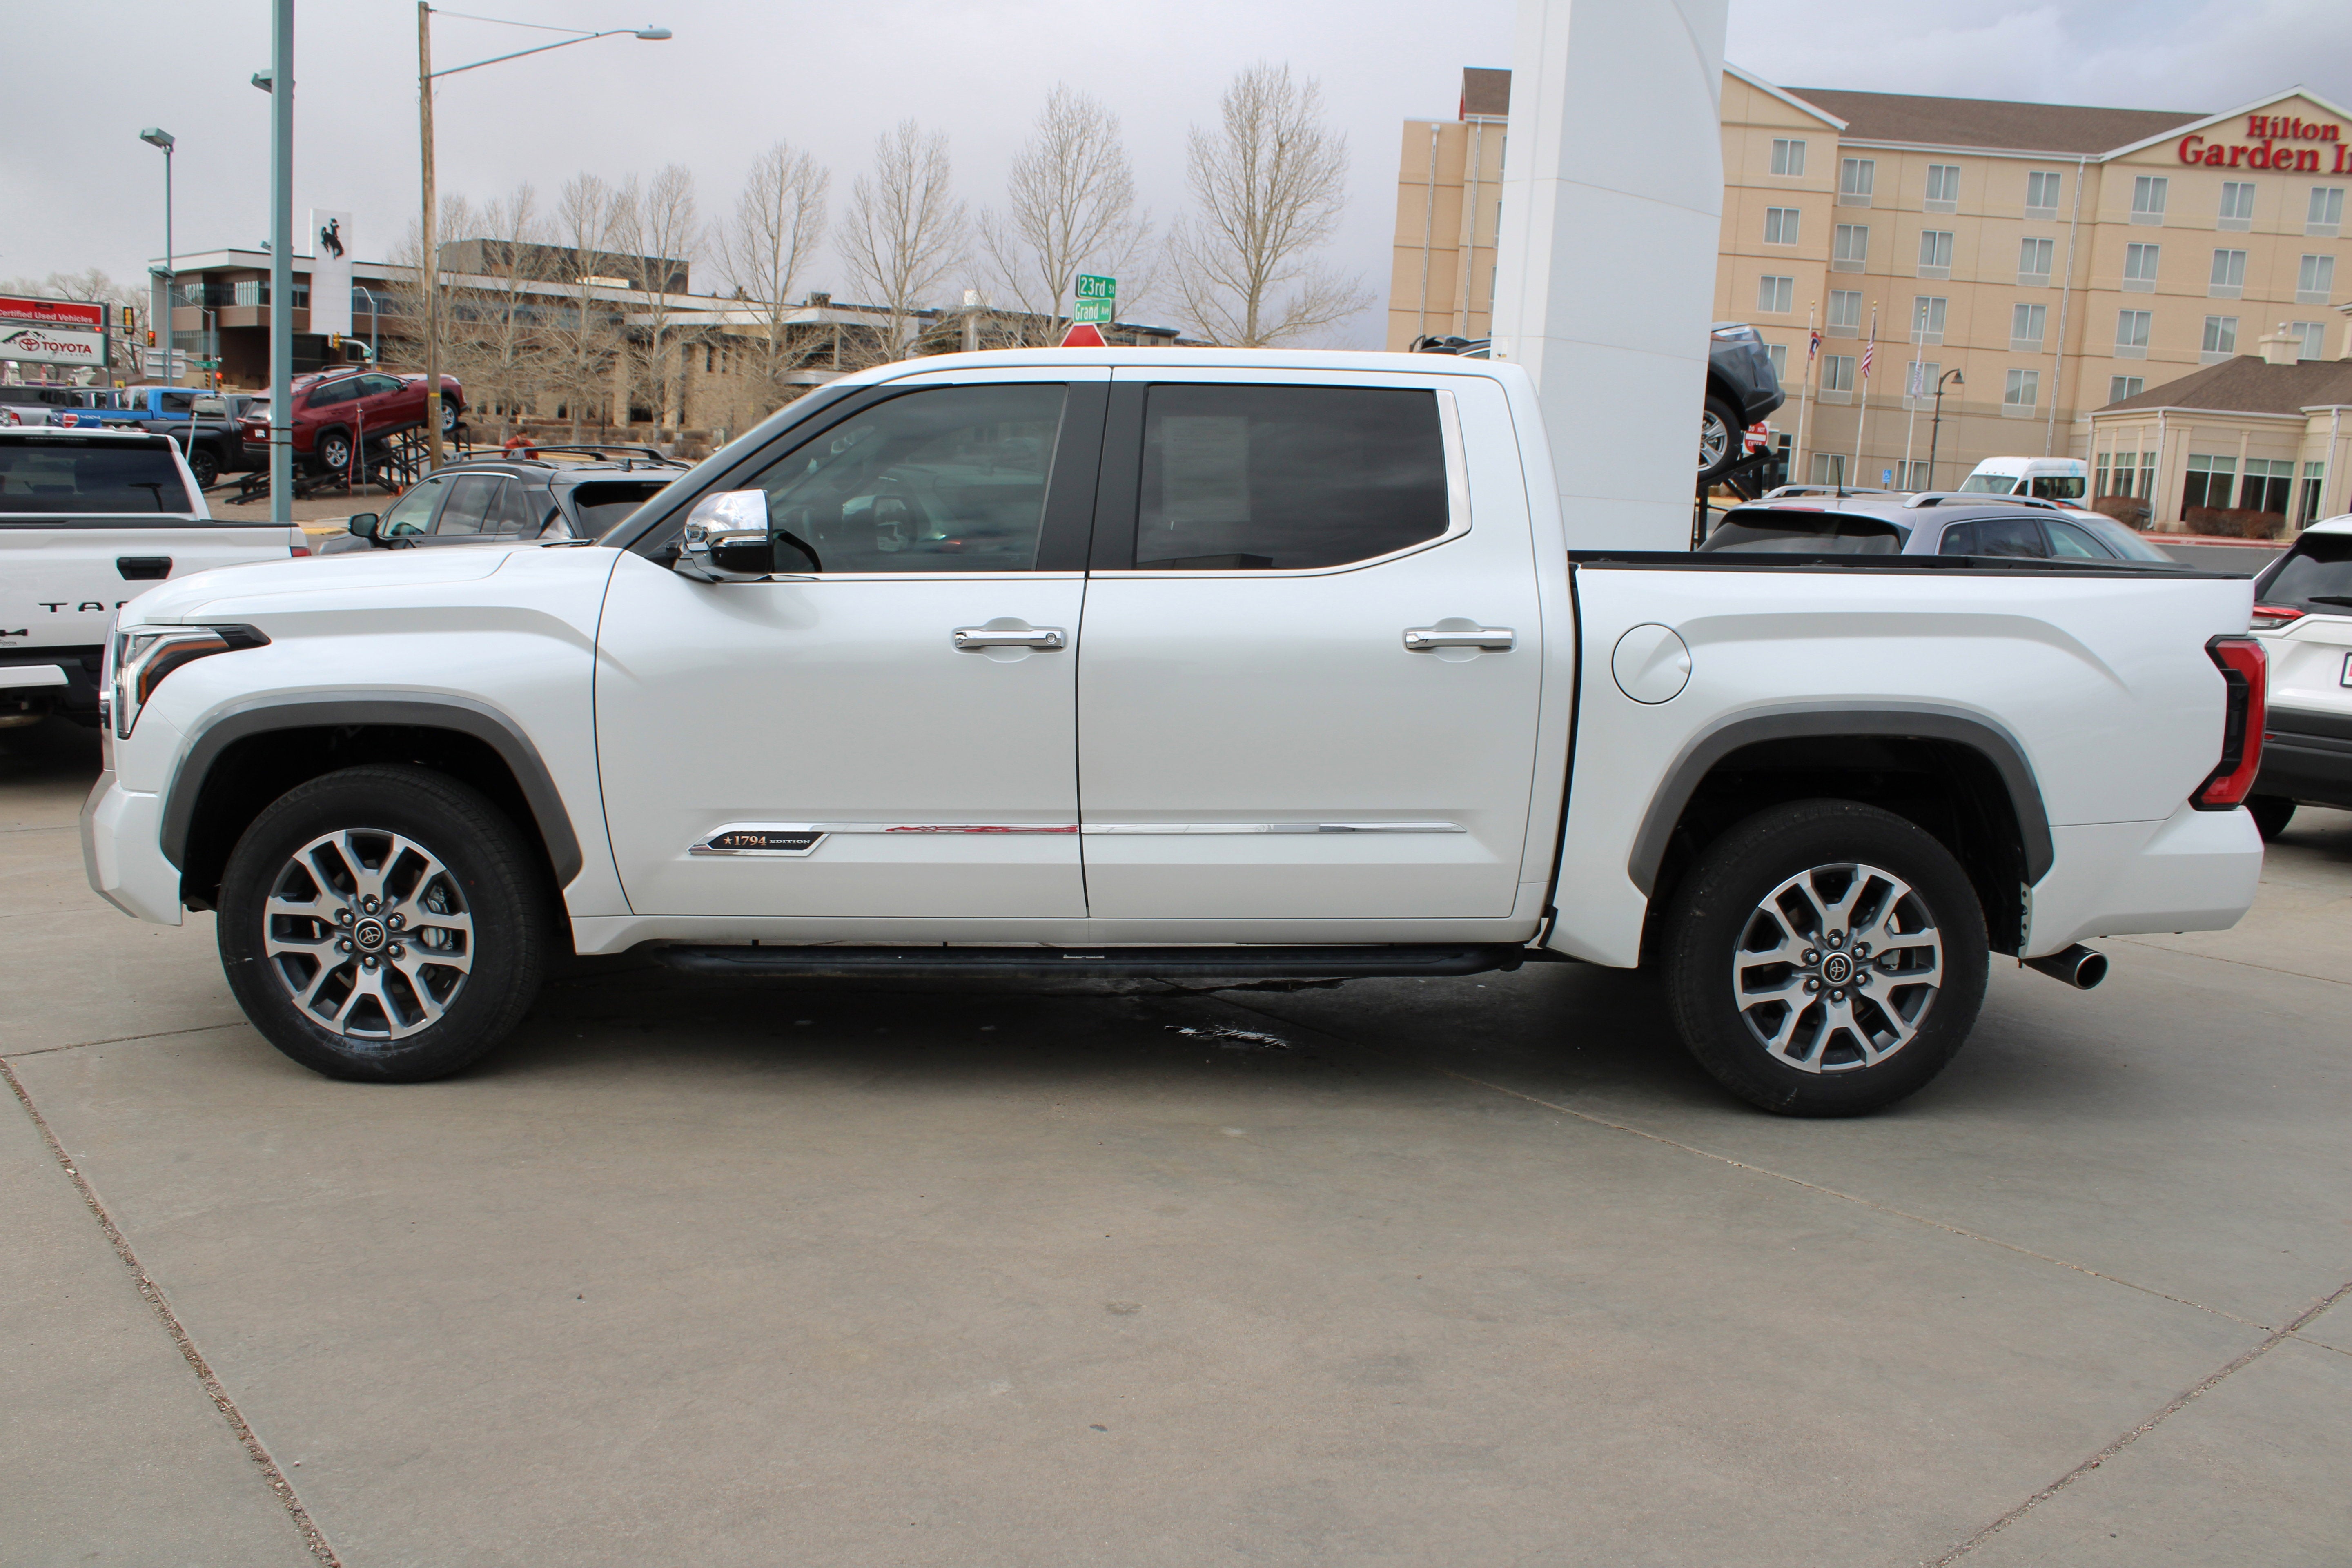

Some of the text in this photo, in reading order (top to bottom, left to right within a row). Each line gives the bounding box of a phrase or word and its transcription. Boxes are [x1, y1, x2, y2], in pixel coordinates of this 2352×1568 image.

[2247, 115, 2340, 140] Hilton
[2179, 135, 2352, 174] Garden I
[1080, 277, 1114, 297] 23rd St
[34, 312, 56, 320] Used
[58, 314, 93, 323] Vehicles
[1075, 303, 1109, 321] Grand Ave
[42, 341, 92, 354] TOYOTA
[734, 836, 767, 846] 1794
